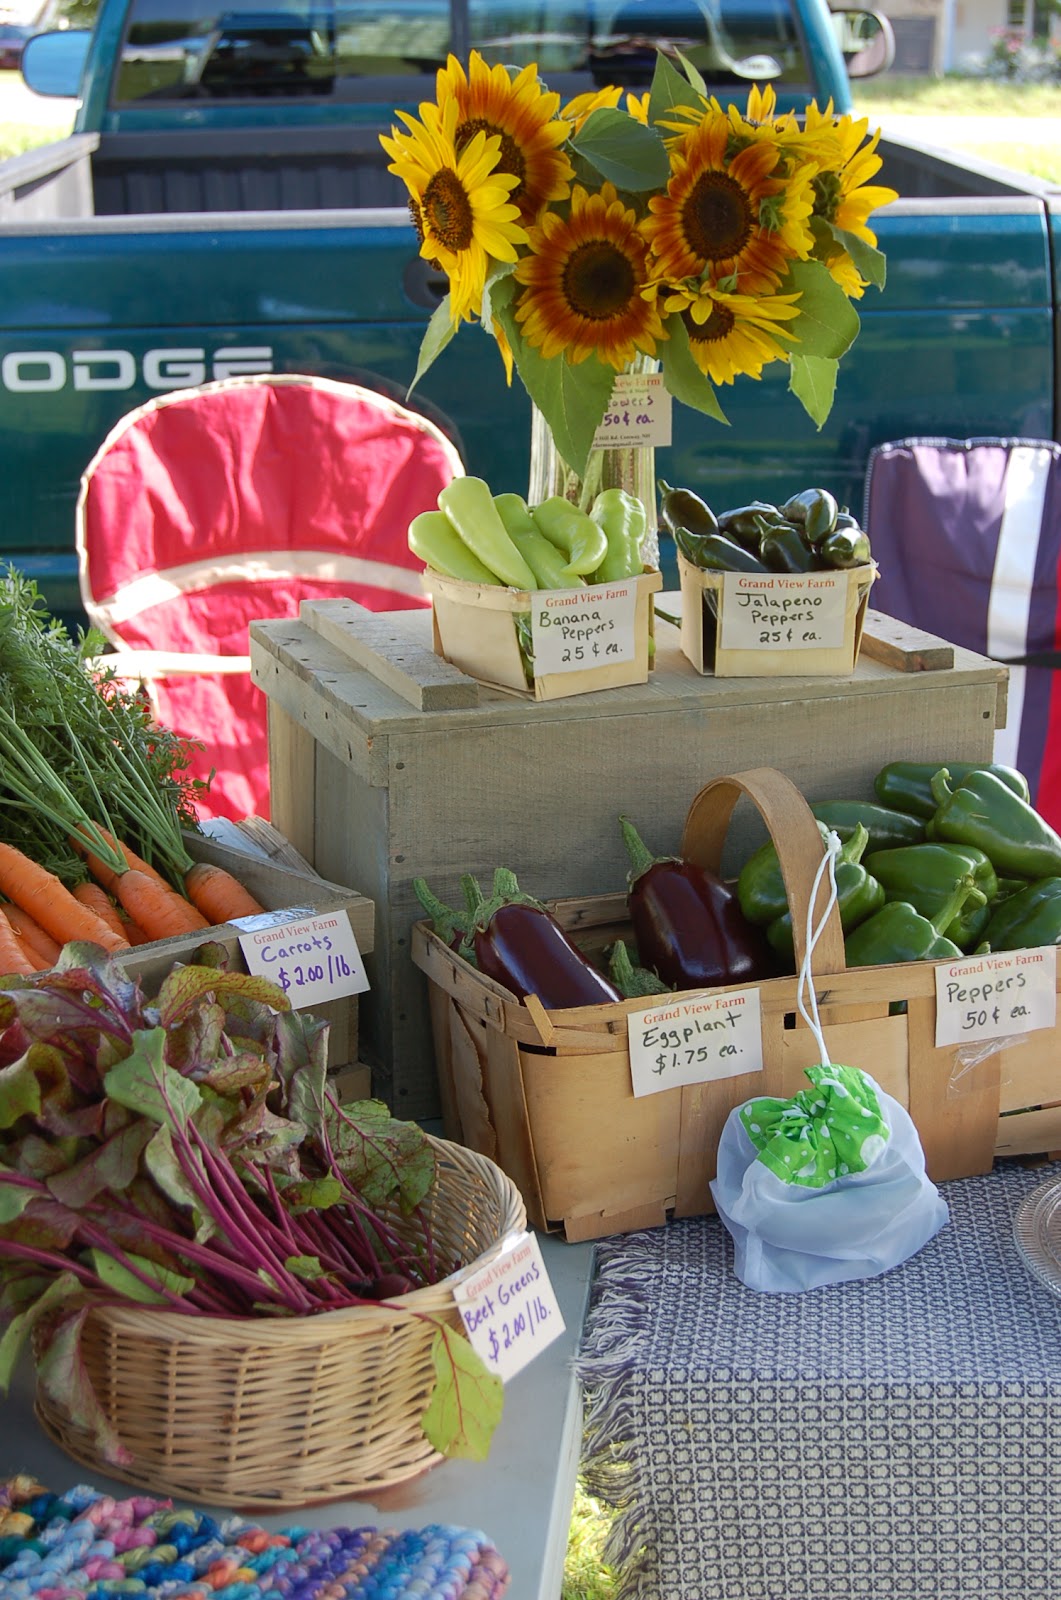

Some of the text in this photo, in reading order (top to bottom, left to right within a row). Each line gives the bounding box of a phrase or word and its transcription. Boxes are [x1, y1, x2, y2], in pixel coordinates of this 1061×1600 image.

[608, 395, 654, 408] owers
[604, 410, 654, 427] 50¢ ea.
[739, 578, 835, 589] Grand View Farm
[546, 589, 628, 608] Grand View Farm
[736, 592, 822, 612] Jalapeno
[540, 611, 601, 628] Banana
[752, 610, 814, 626] Peppers
[562, 620, 615, 640] Peppers
[802, 631, 822, 641] ea.
[606, 643, 623, 655] ea.
[253, 919, 338, 945] Grand View Farm
[261, 936, 332, 962] Carrots
[949, 954, 1043, 977] Grand View Farm
[946, 973, 1026, 1003] Peppers
[643, 997, 746, 1025] Grand View Farm
[1010, 1005, 1031, 1018] ea.
[642, 1010, 742, 1048] Eggplant
[652, 1044, 743, 1075] $1.75 ea.
[465, 1246, 531, 1298] Grand View Farm
[464, 1262, 540, 1332] Beet Greens
